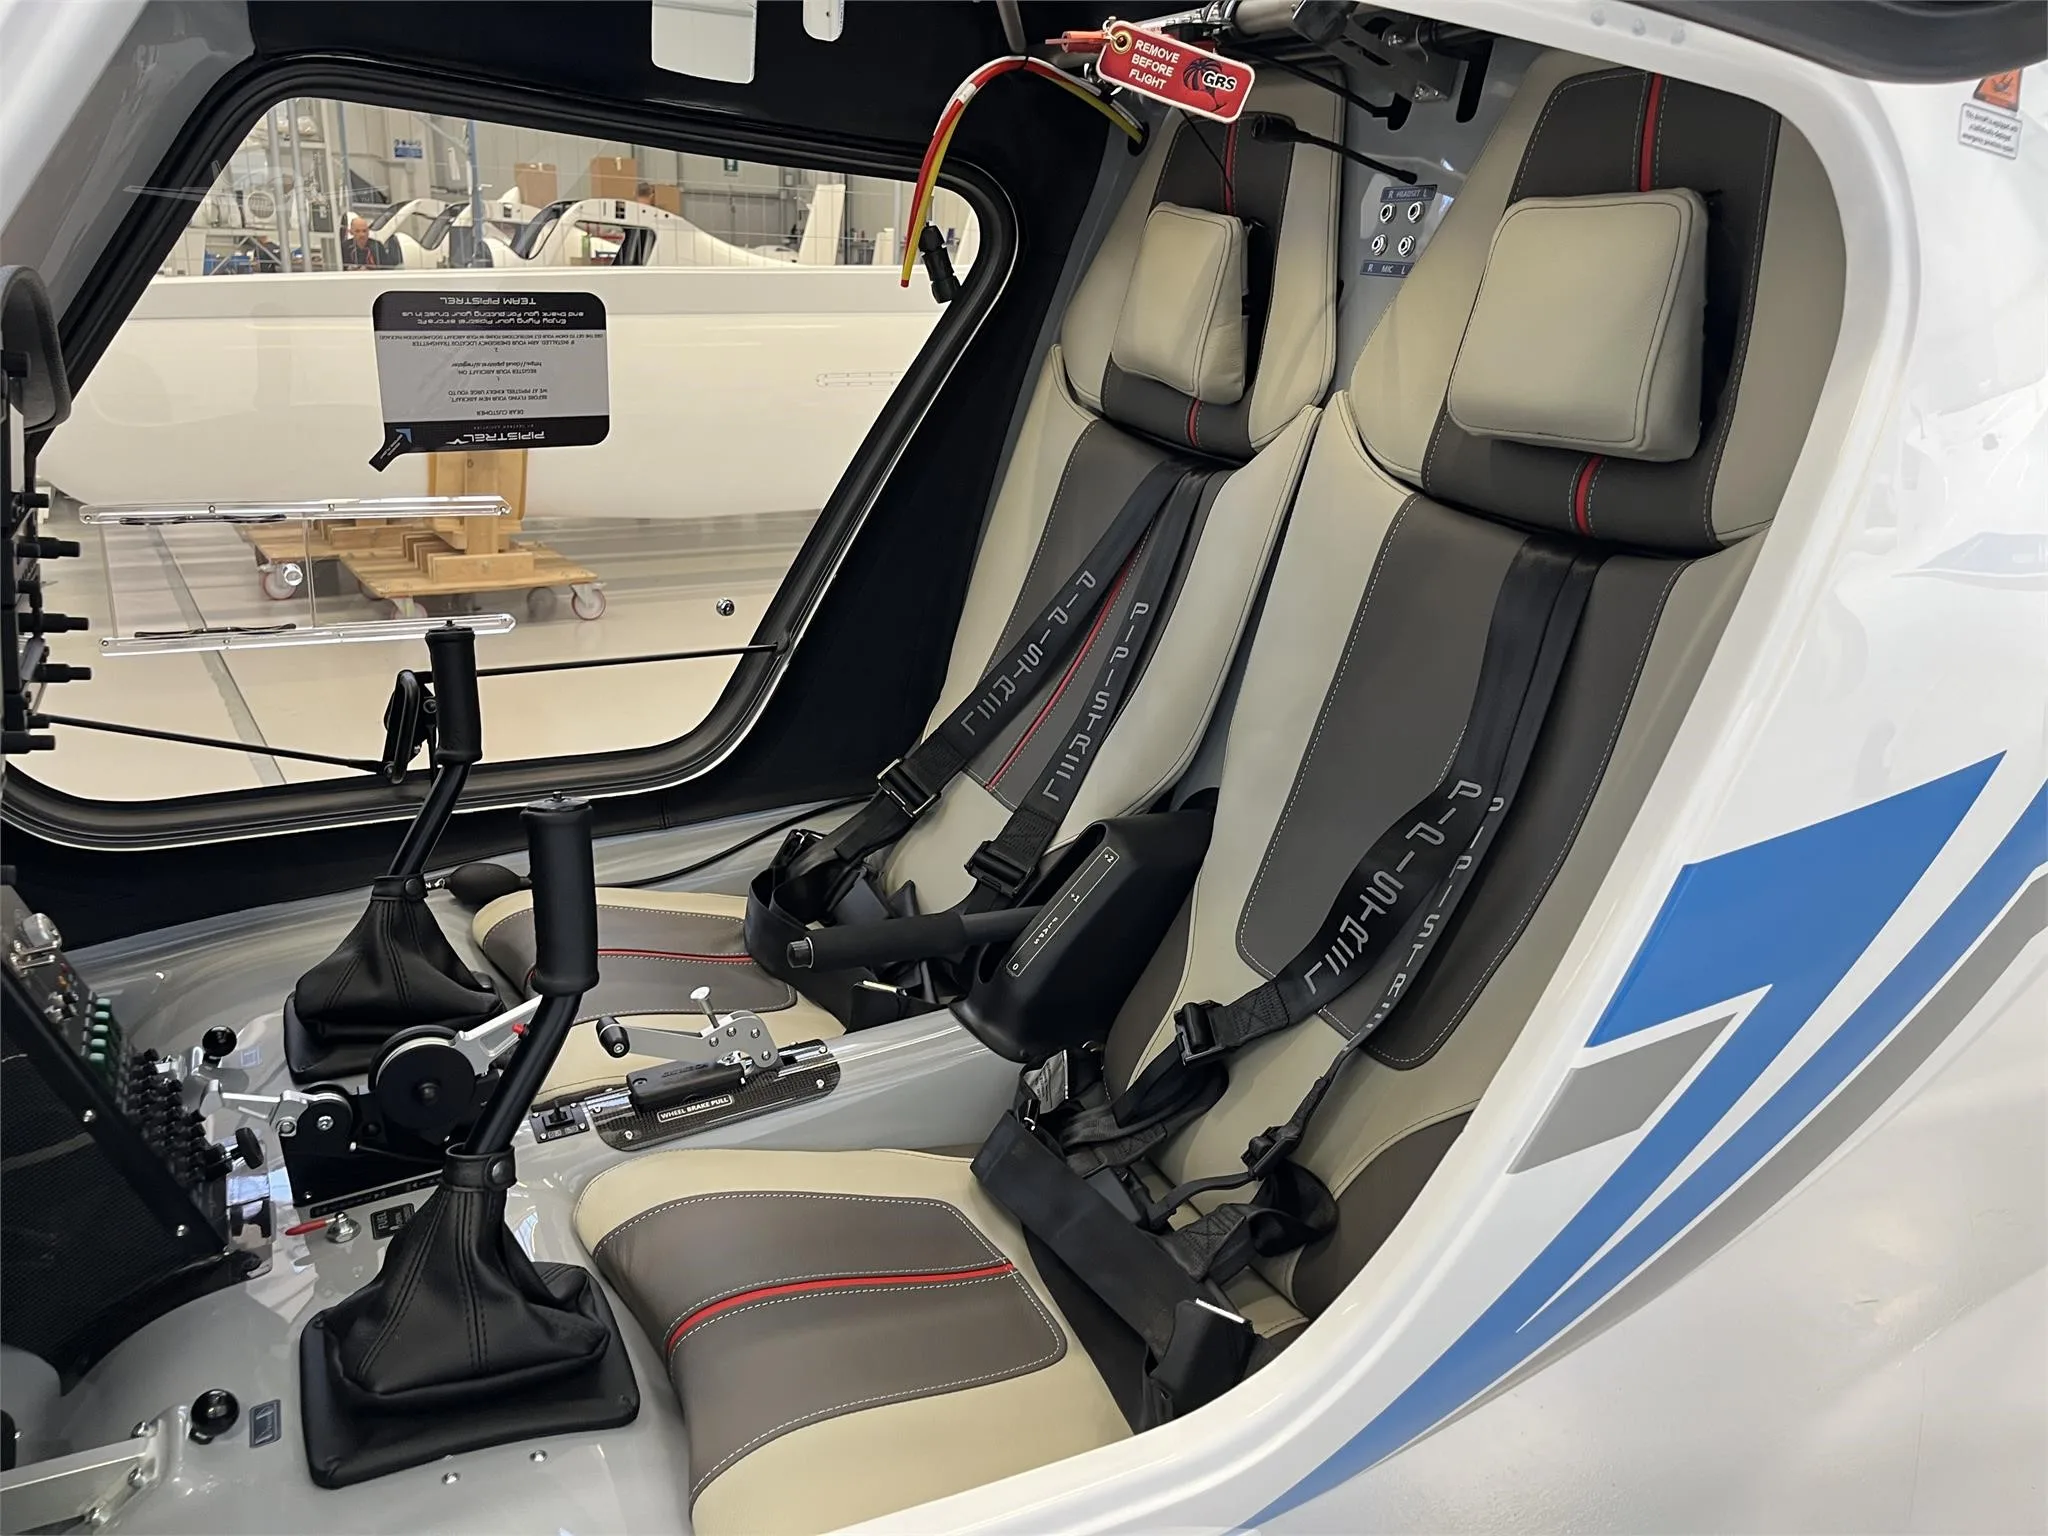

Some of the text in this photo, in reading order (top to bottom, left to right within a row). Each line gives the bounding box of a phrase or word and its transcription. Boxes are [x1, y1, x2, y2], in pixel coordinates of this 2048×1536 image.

[1134, 40, 1180, 63] REMOVE
[1131, 54, 1174, 77] BEFORE
[1128, 68, 1167, 90] FLIGHT
[1202, 71, 1237, 92] GRS
[1388, 190, 1394, 199] R
[1368, 263, 1406, 275] R MIC L
[440, 297, 536, 305] TEAM PIPISTREL
[463, 431, 545, 442] PIPISTREL
[961, 570, 1096, 736] PIPISTREL
[1042, 602, 1149, 801] PIPISTREL
[1104, 853, 1114, 863] +2
[1071, 893, 1079, 902] +1
[1303, 780, 1482, 995] PIPISTREL
[1034, 916, 1058, 944] FLAPS
[660, 1097, 728, 1119] WHEEL BRAKE PULL
[376, 1211, 389, 1230] FUEL
